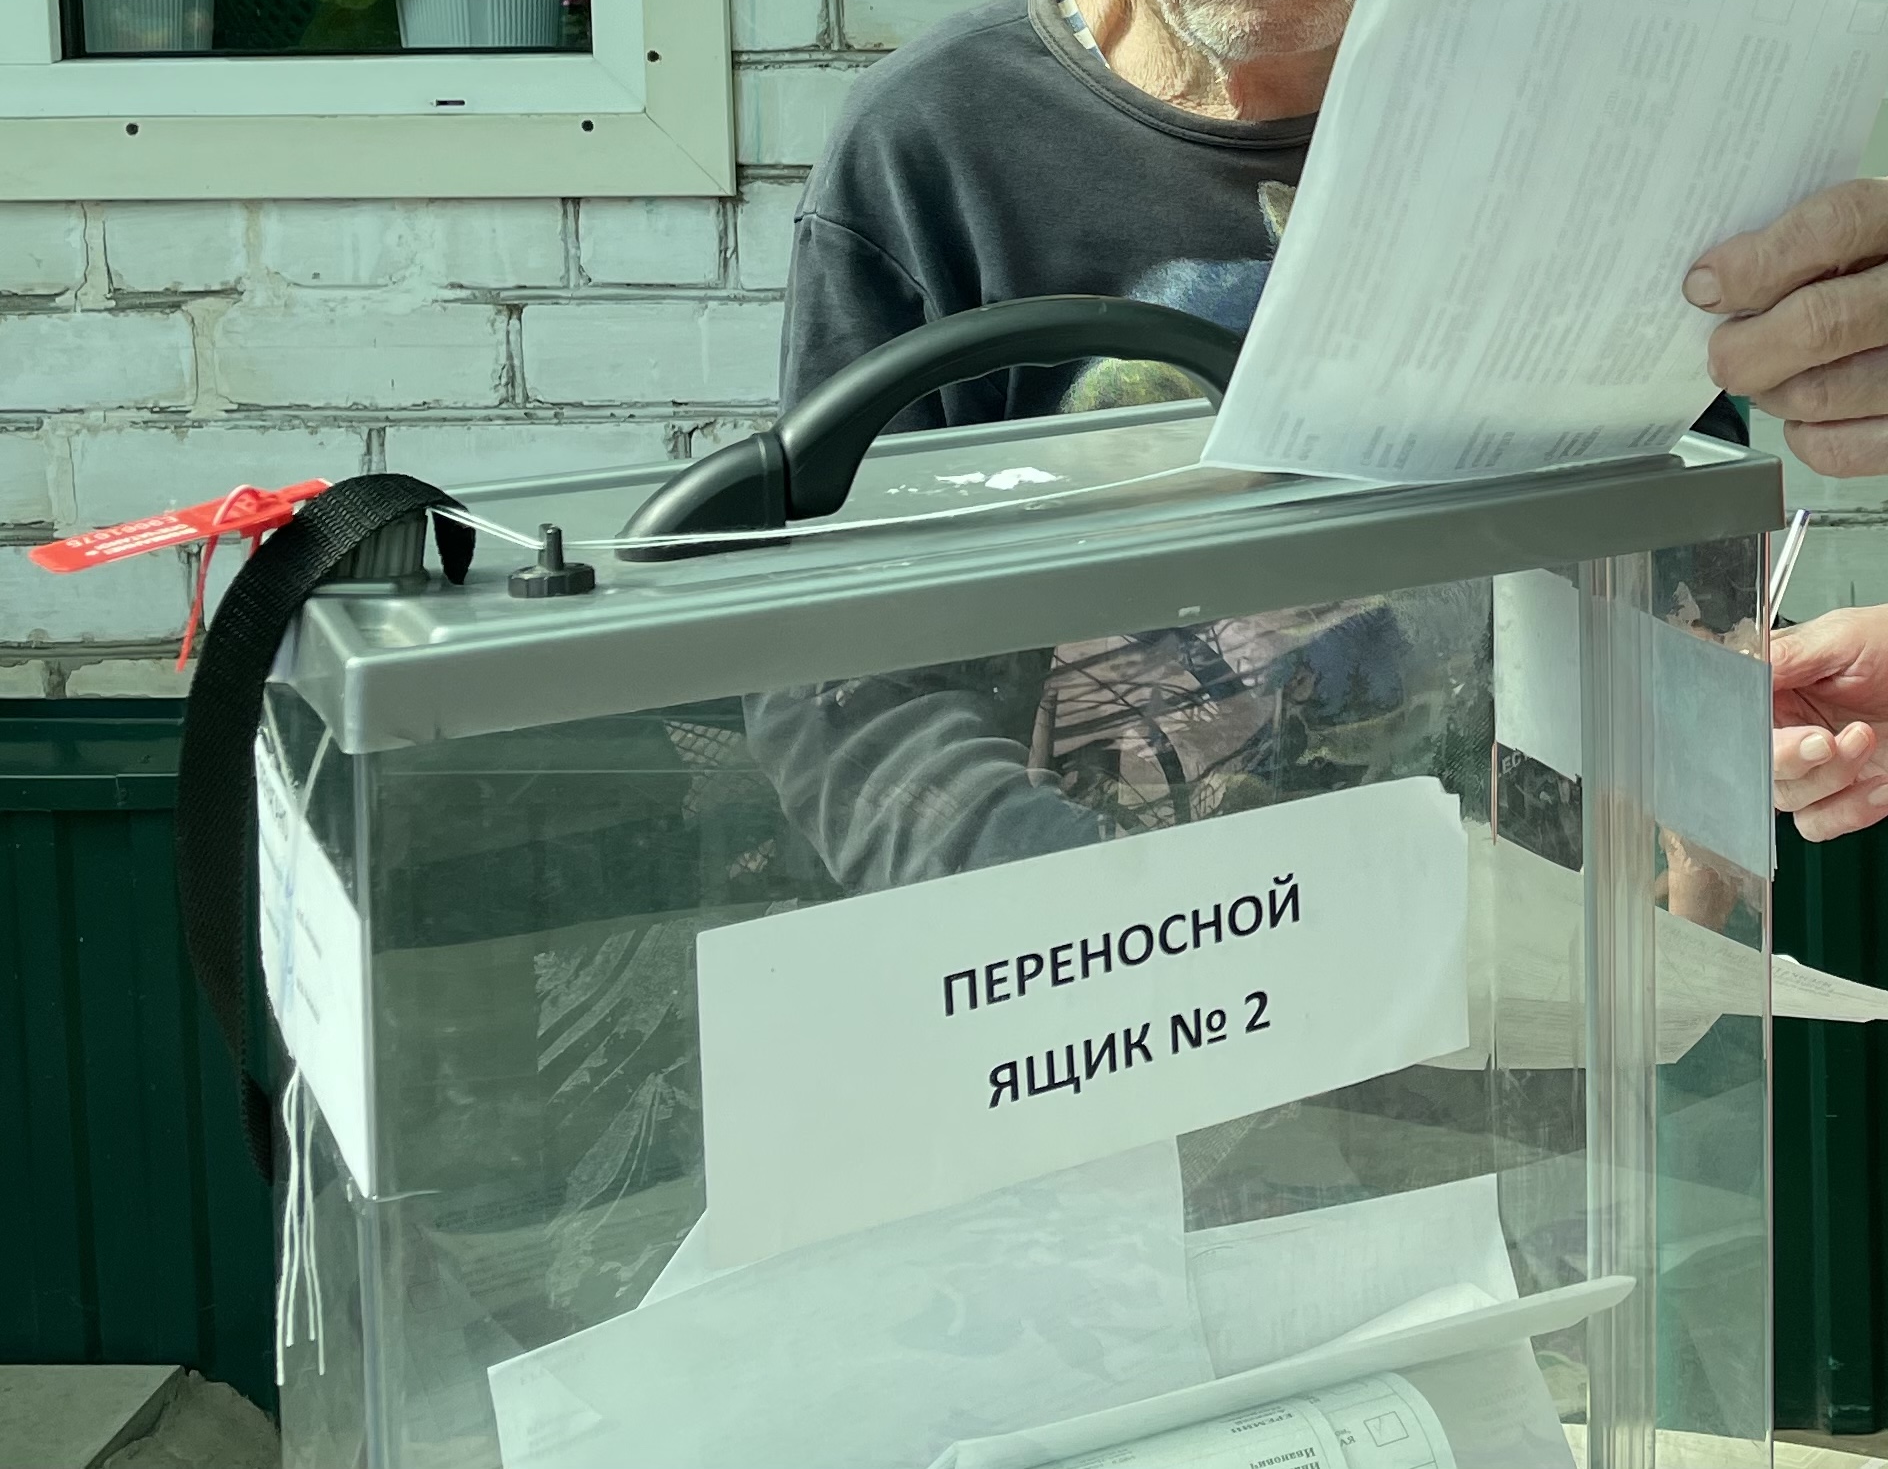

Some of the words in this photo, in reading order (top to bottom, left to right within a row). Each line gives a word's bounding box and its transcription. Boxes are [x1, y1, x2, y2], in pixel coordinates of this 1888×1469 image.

[943, 872, 1301, 1016] ПЕРЕНОСНОЙ
[989, 1021, 1153, 1109] ЯЩИК
[1170, 1007, 1227, 1055] №
[1244, 990, 1271, 1034] 2
[1250, 1446, 1317, 1469] Иванович
